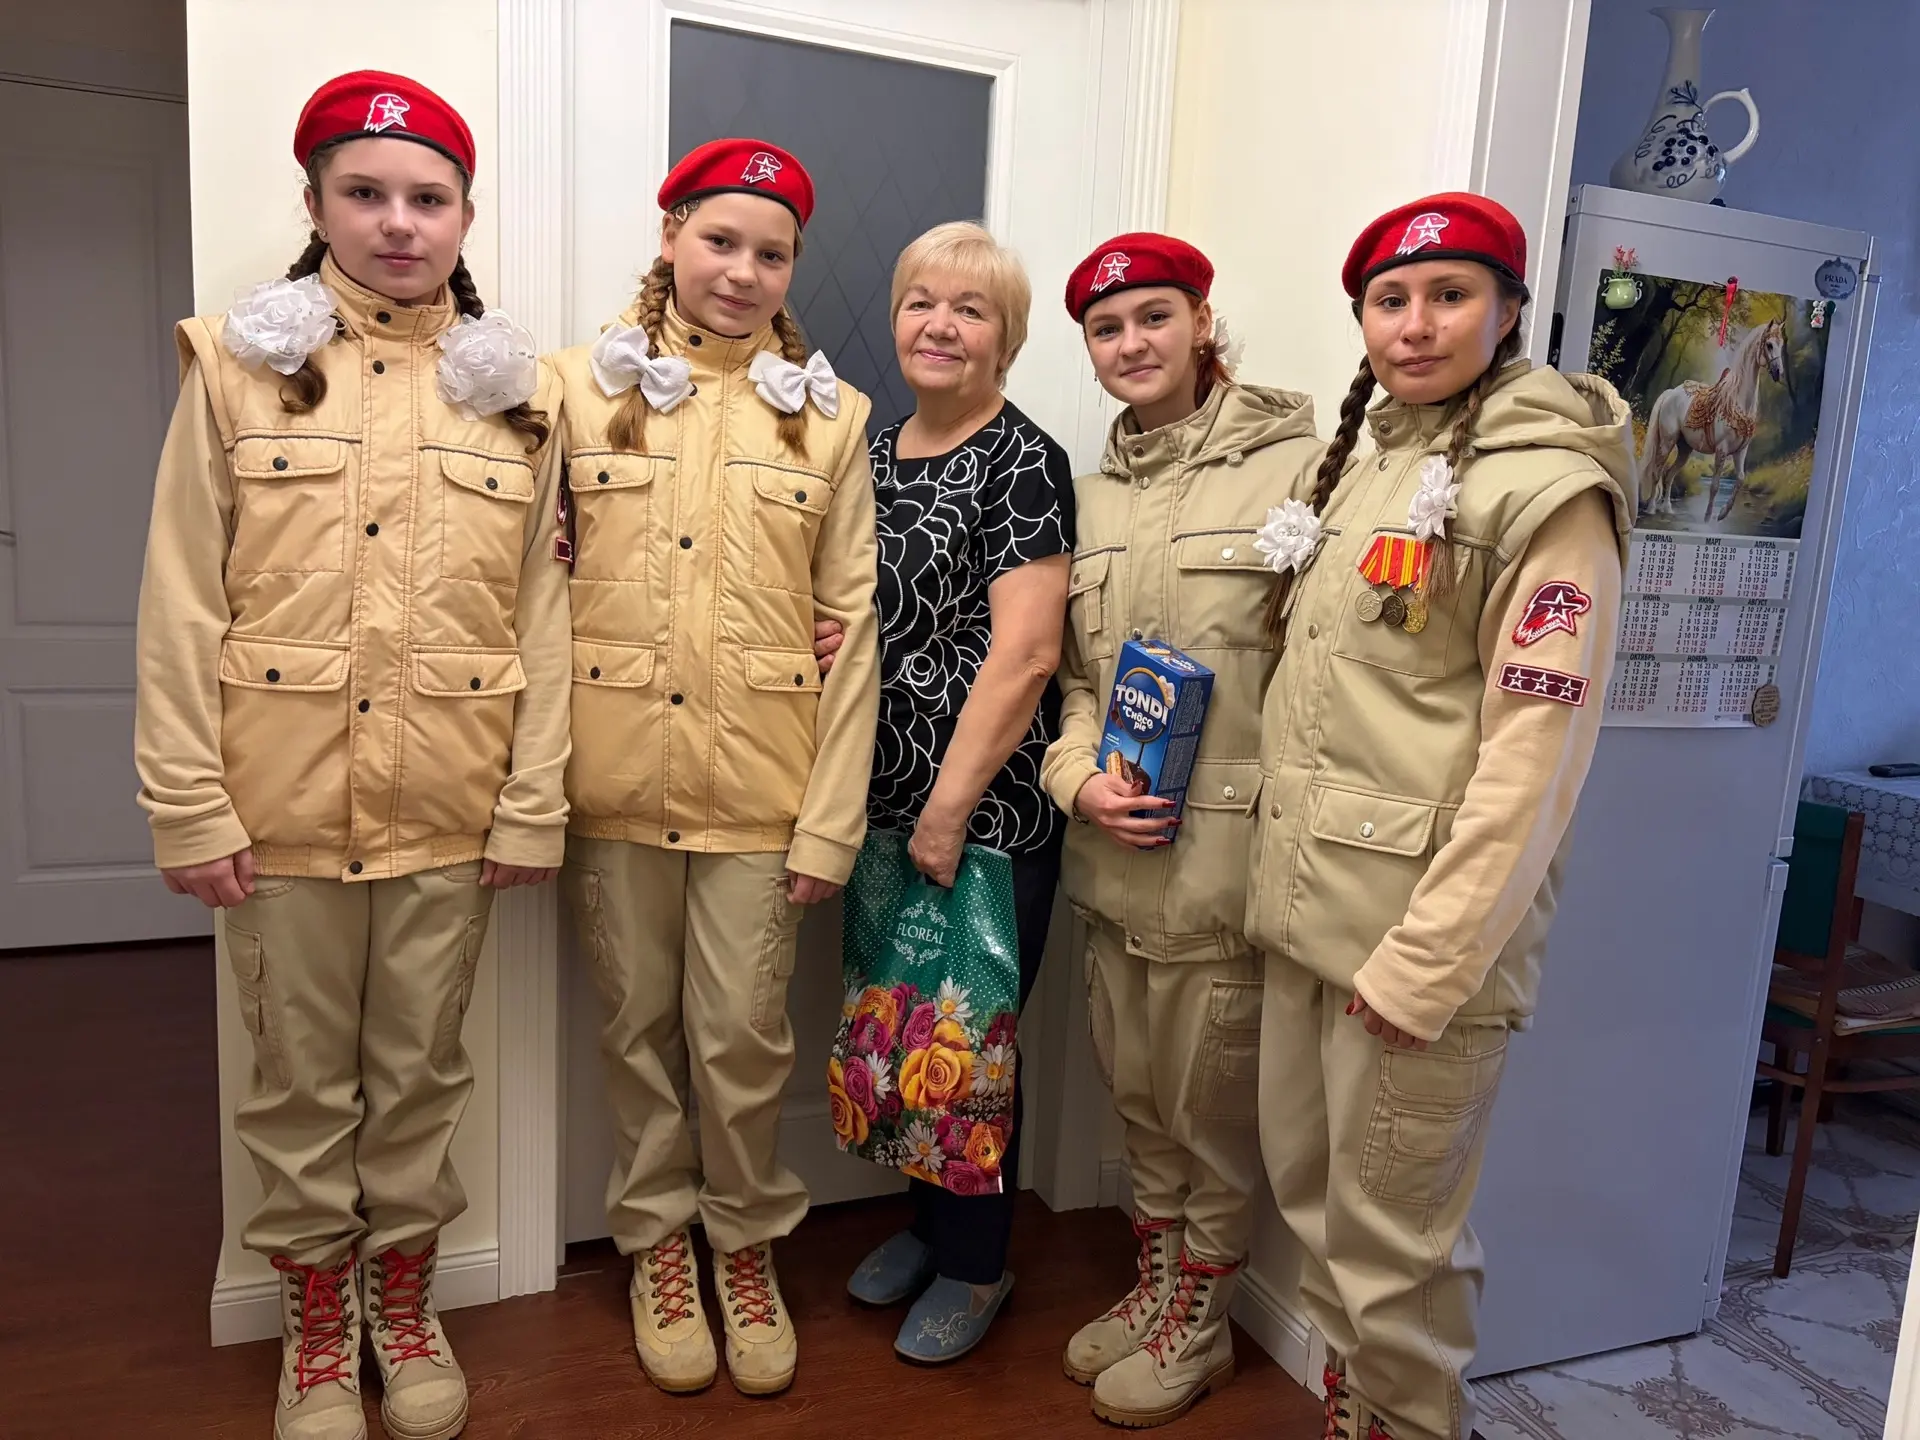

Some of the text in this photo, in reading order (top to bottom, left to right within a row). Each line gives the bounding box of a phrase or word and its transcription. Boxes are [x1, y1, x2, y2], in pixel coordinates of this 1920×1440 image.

[1824, 274, 1848, 285] PRADA
[1645, 534, 1673, 543] ФЕВРАЛЬ
[1706, 538, 1722, 546] МАРТ
[1755, 541, 1776, 549] АПРЕЛЬ
[1643, 594, 1661, 602] ИЮНЬ
[1630, 653, 1655, 661] ОКТЯБРЬ
[1687, 655, 1708, 663] НОЯБРЬ
[1115, 684, 1169, 726] TONDI
[896, 923, 944, 944] FLOREAL
